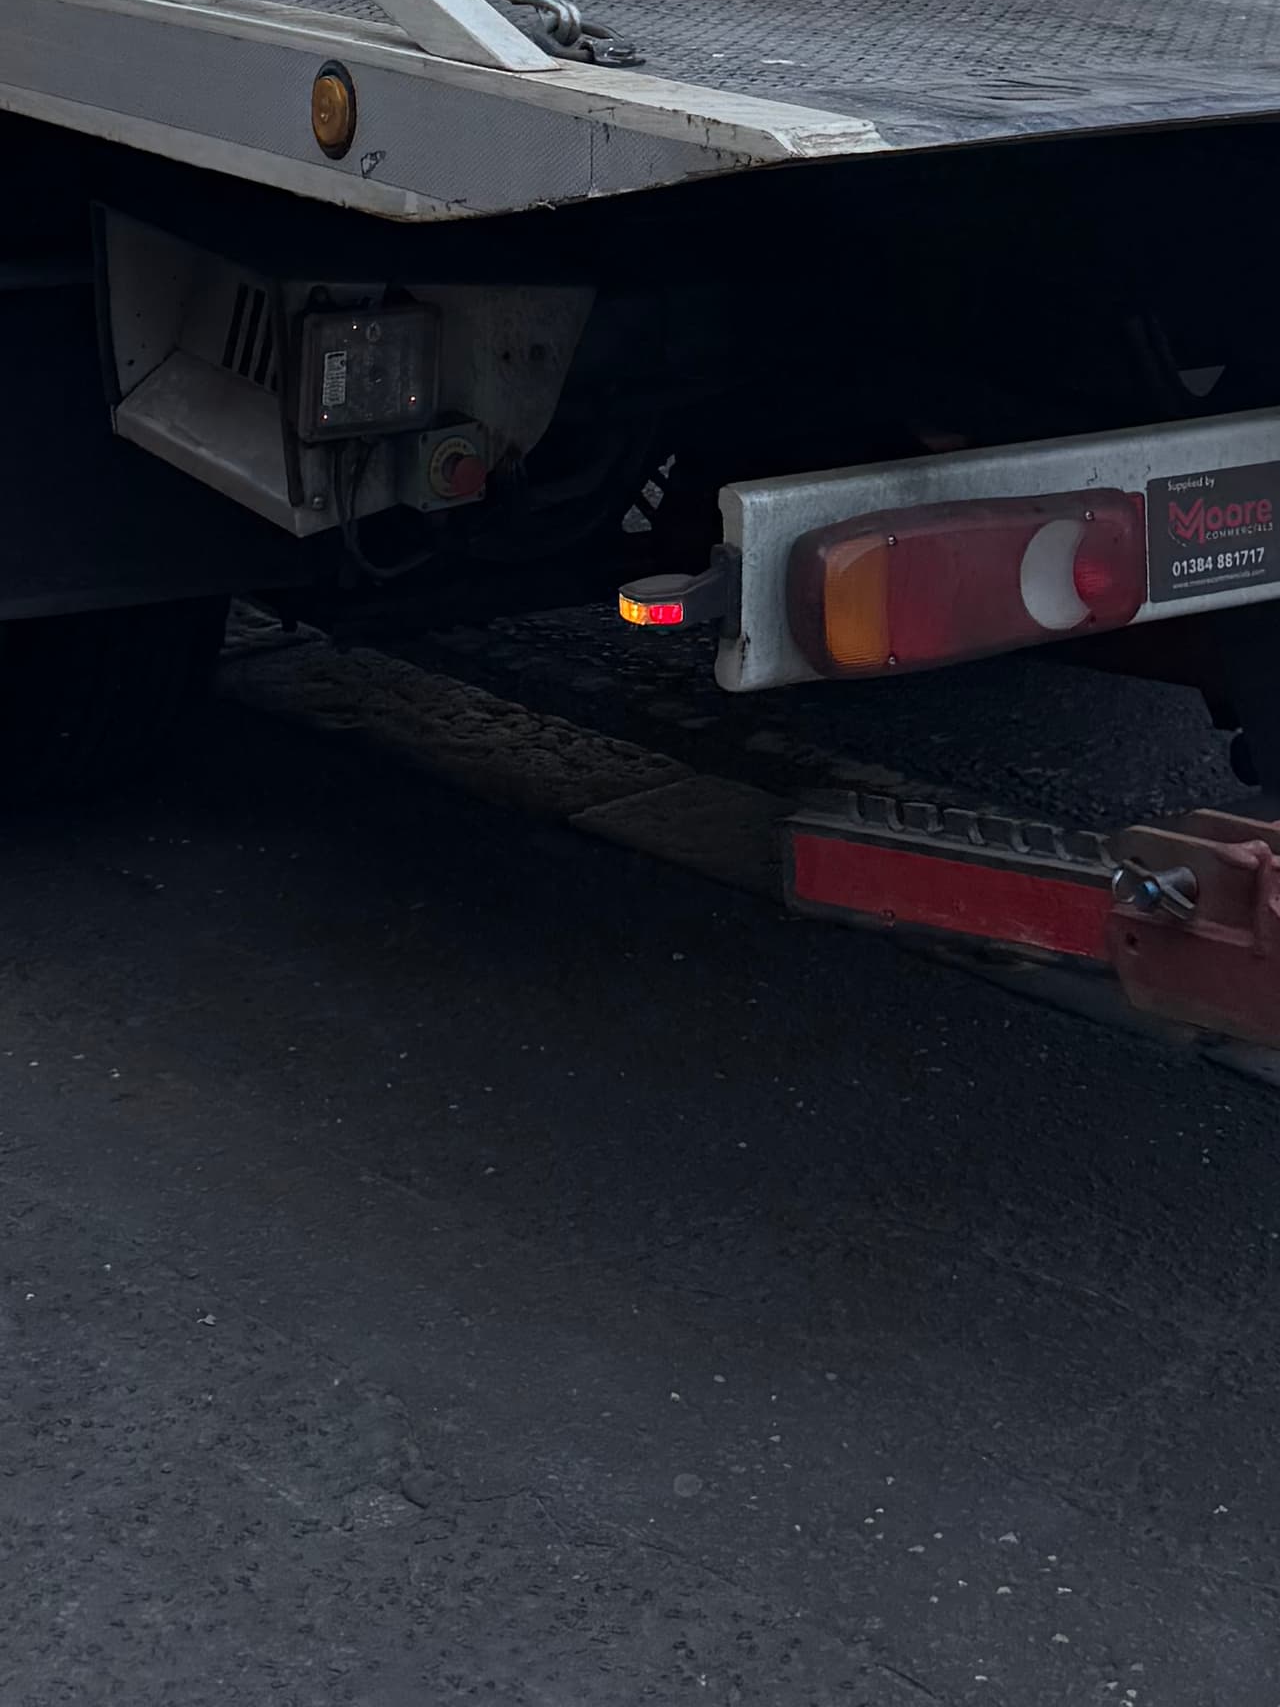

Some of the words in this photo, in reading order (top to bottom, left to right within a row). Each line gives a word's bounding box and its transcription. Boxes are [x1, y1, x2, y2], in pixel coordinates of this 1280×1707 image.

[1167, 475, 1203, 493] Supplied
[1205, 475, 1216, 489] by
[1167, 498, 1273, 545] Moore
[1172, 556, 1214, 577] 01384
[1217, 547, 1266, 569] 881717
